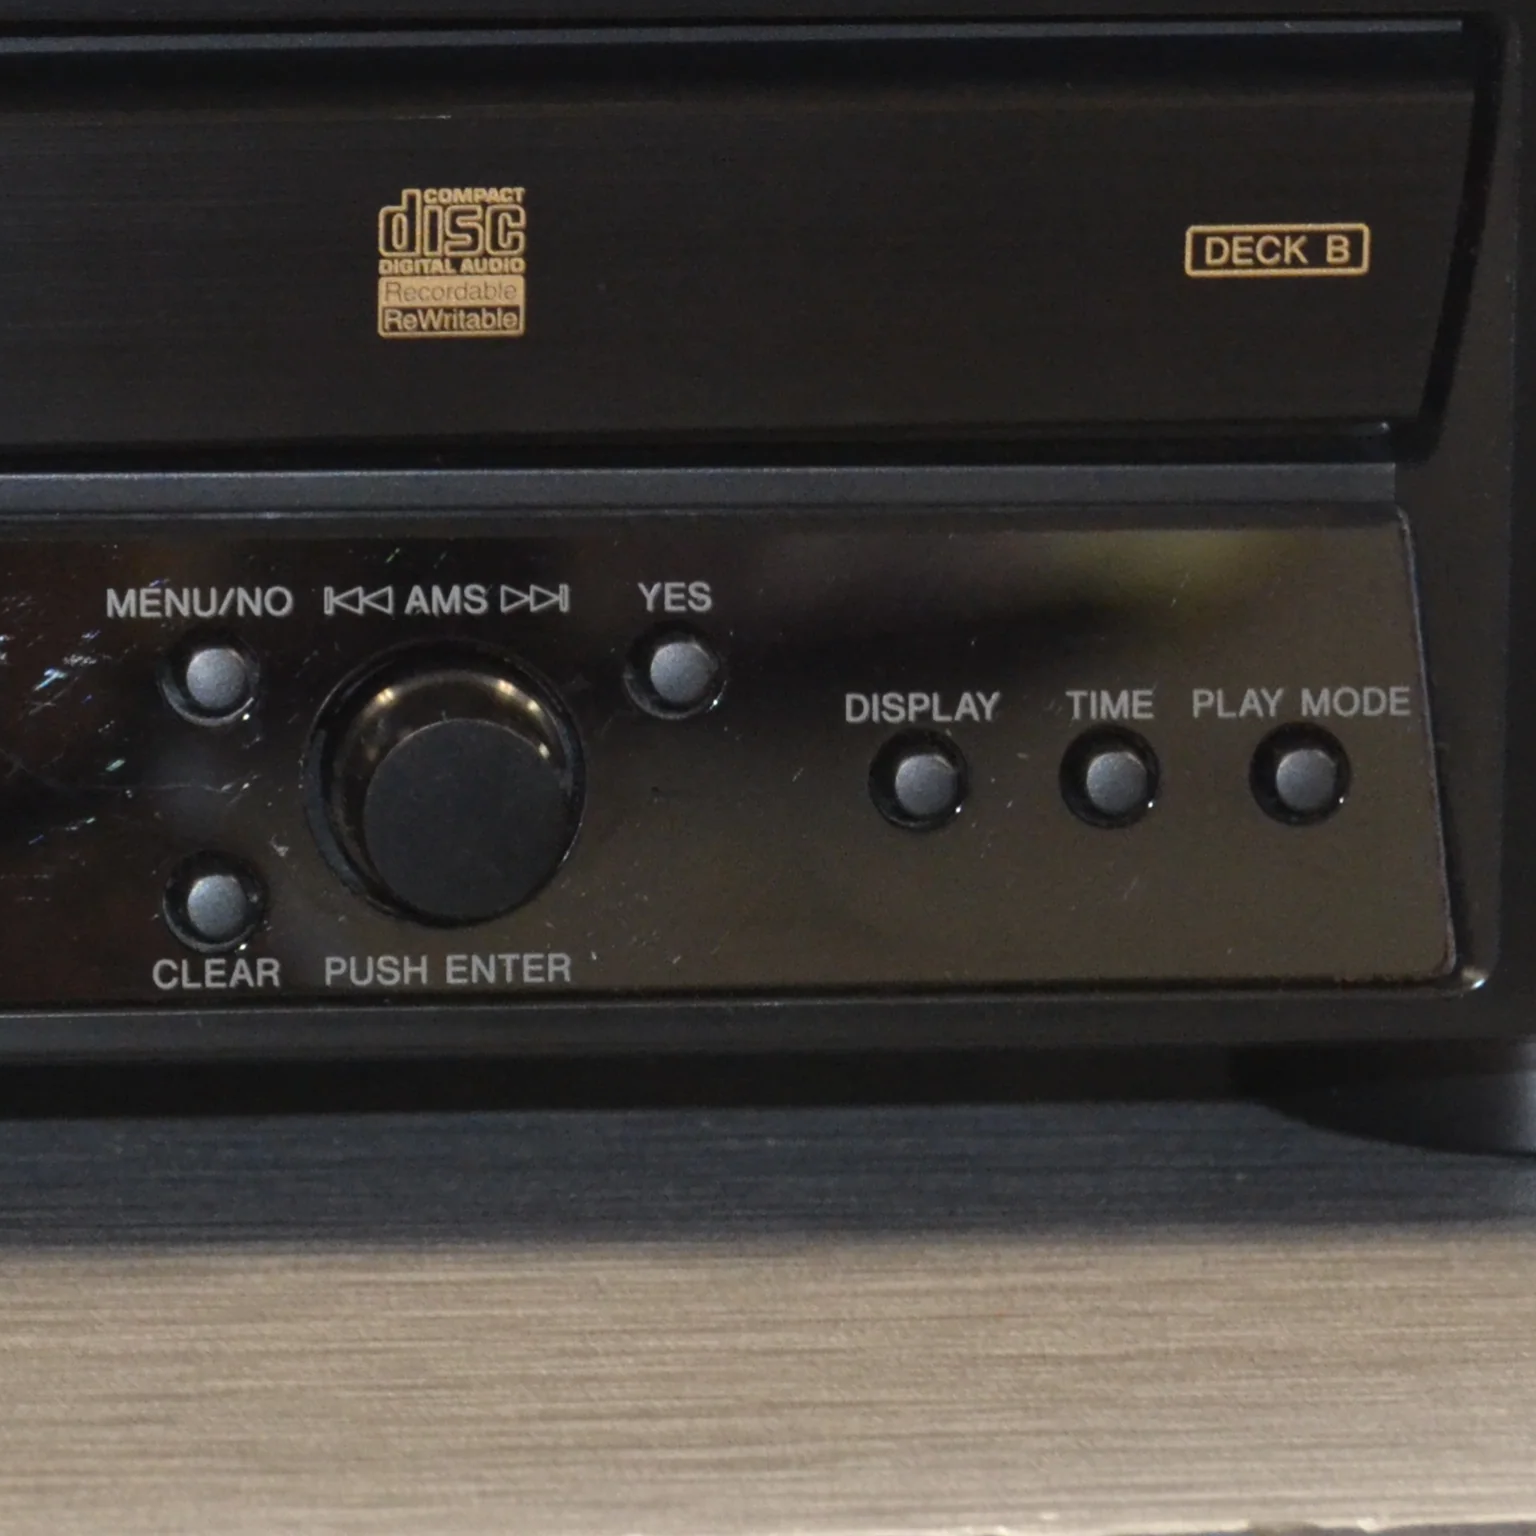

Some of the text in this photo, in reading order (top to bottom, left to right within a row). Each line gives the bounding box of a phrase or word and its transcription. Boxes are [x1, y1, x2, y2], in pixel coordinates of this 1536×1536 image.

[424, 187, 525, 204] COMPACT
[1205, 234, 1350, 265] DECK B
[379, 258, 526, 275] DIGITAL AUDIO
[384, 281, 517, 302] Recordable
[384, 307, 517, 331] ReWritable
[107, 586, 293, 618] MENU/NO
[405, 584, 488, 615] AMS
[638, 582, 712, 611] YES
[845, 691, 1000, 723] DISPLAY
[1066, 690, 1154, 720] TIME
[1192, 687, 1411, 718] PLAY MODE
[152, 958, 280, 989] CLEAR
[325, 954, 570, 986] PUSH ENTER
